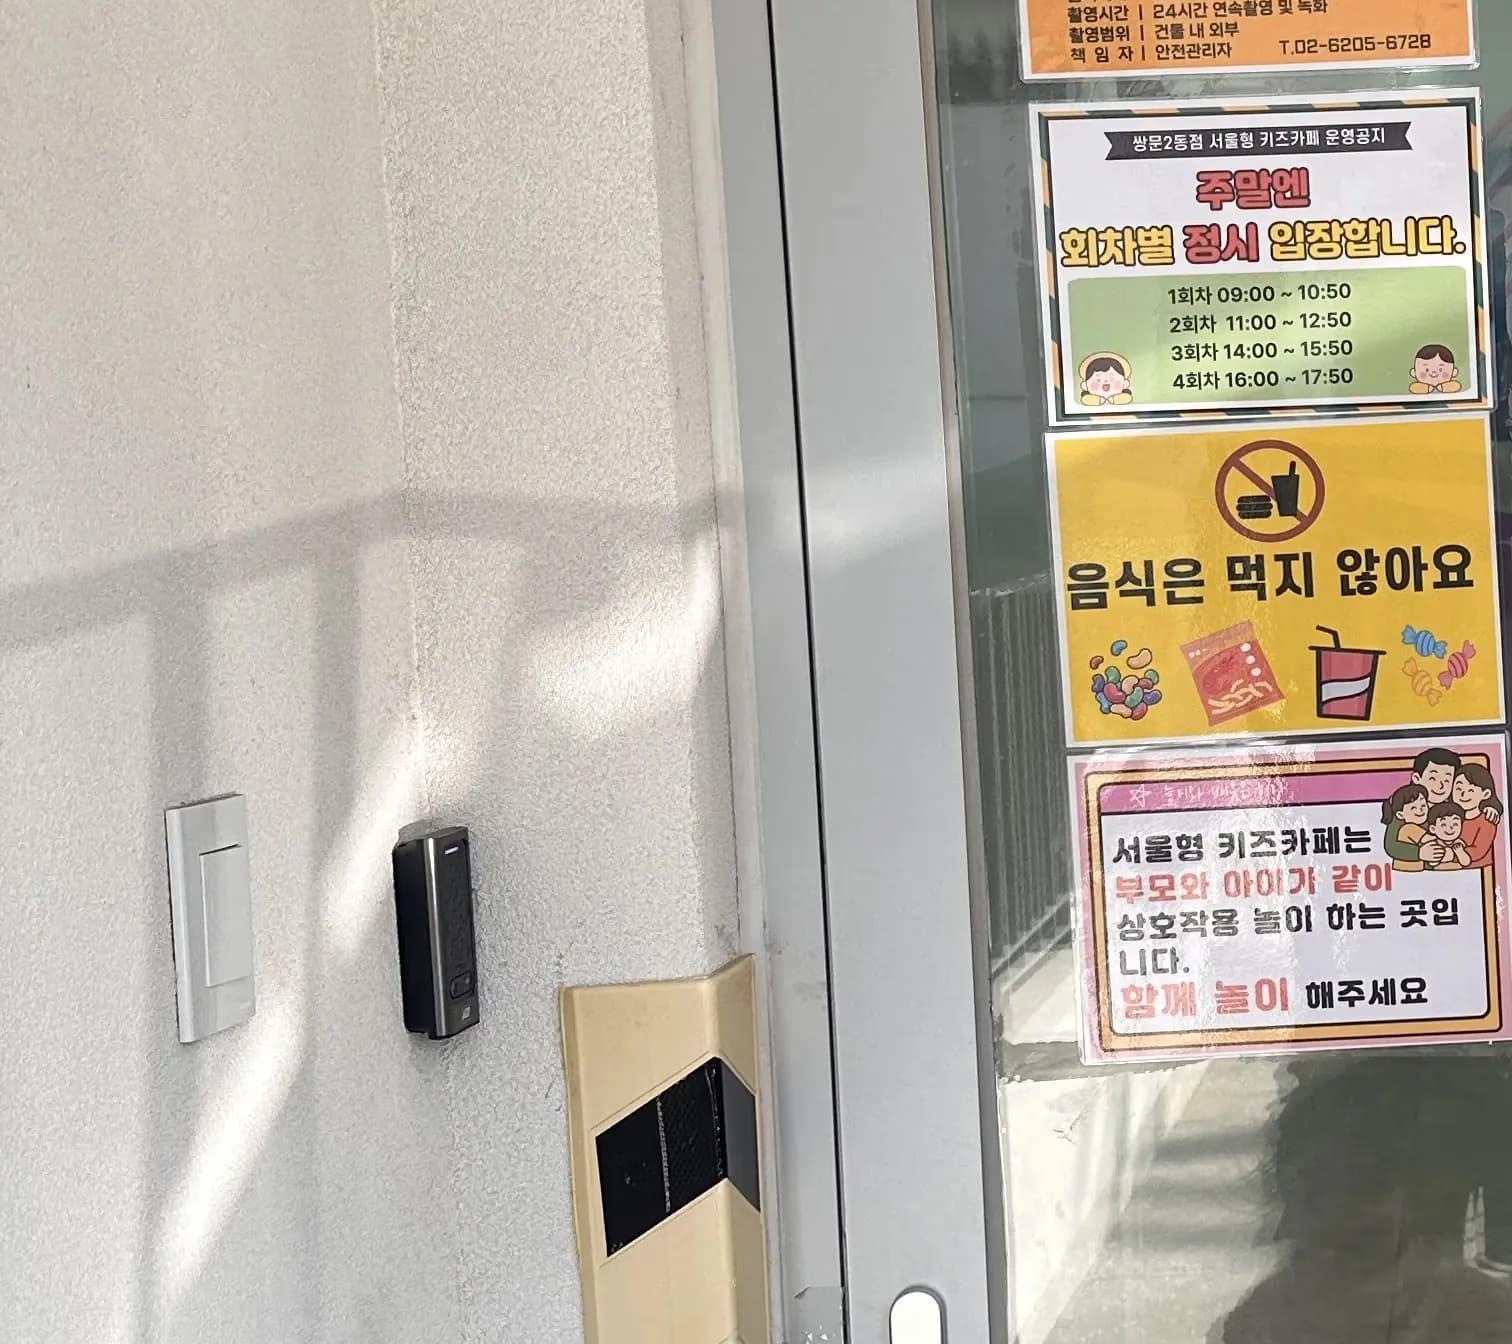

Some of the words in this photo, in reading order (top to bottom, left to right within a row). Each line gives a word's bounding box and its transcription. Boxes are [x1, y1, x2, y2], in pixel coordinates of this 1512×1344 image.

[1067, 5, 1129, 24] 촬영시간
[1152, 1, 1208, 19] 24시간
[1068, 25, 1130, 44] 촬영범위
[1154, 22, 1185, 40] 건물
[1189, 21, 1205, 39] 내
[1208, 20, 1240, 38] 외부
[1155, 41, 1233, 61] 안전관리자
[1132, 133, 1204, 152] 쌍문2동점
[1208, 132, 1254, 150] 서울형
[1259, 129, 1320, 148] 키즈카페
[1325, 127, 1386, 146] 운영공지
[1195, 166, 1311, 211] 주말엔
[1059, 225, 1175, 268] 회차별
[1182, 221, 1260, 264] 정시
[1268, 215, 1467, 263] 입장합니다.
[1167, 286, 1213, 306] 1회차
[1217, 285, 1276, 304] 09:00
[1297, 282, 1352, 302] 10:50
[1168, 314, 1217, 335] 2회차
[1225, 314, 1277, 332] 11:00
[1298, 311, 1352, 330] 12:50
[1170, 342, 1219, 364] 3회차
[1222, 342, 1278, 361] 14:00
[1300, 339, 1354, 358] 15:50
[1172, 371, 1220, 392] 4회차
[1224, 370, 1279, 389] 16:00
[1300, 367, 1354, 386] 17:50
[1066, 557, 1205, 611] 음식은
[1226, 551, 1315, 602] 먹지
[1336, 543, 1475, 598] 않아요
[1112, 832, 1204, 864] 서울형
[1217, 825, 1373, 860] 키즈카페는
[1114, 871, 1211, 905] 부모와
[1223, 866, 1317, 899] 아이가
[1332, 862, 1394, 894] 같이
[1116, 907, 1239, 942] 상호작용
[1253, 904, 1313, 936] 놀이
[1326, 901, 1387, 932] 하는
[1400, 897, 1460, 928] 곳입
[1119, 946, 1191, 978] 니다.
[1120, 980, 1198, 1020] 함께
[1214, 977, 1290, 1016] 놀이
[1305, 976, 1429, 1011] 해주세요
